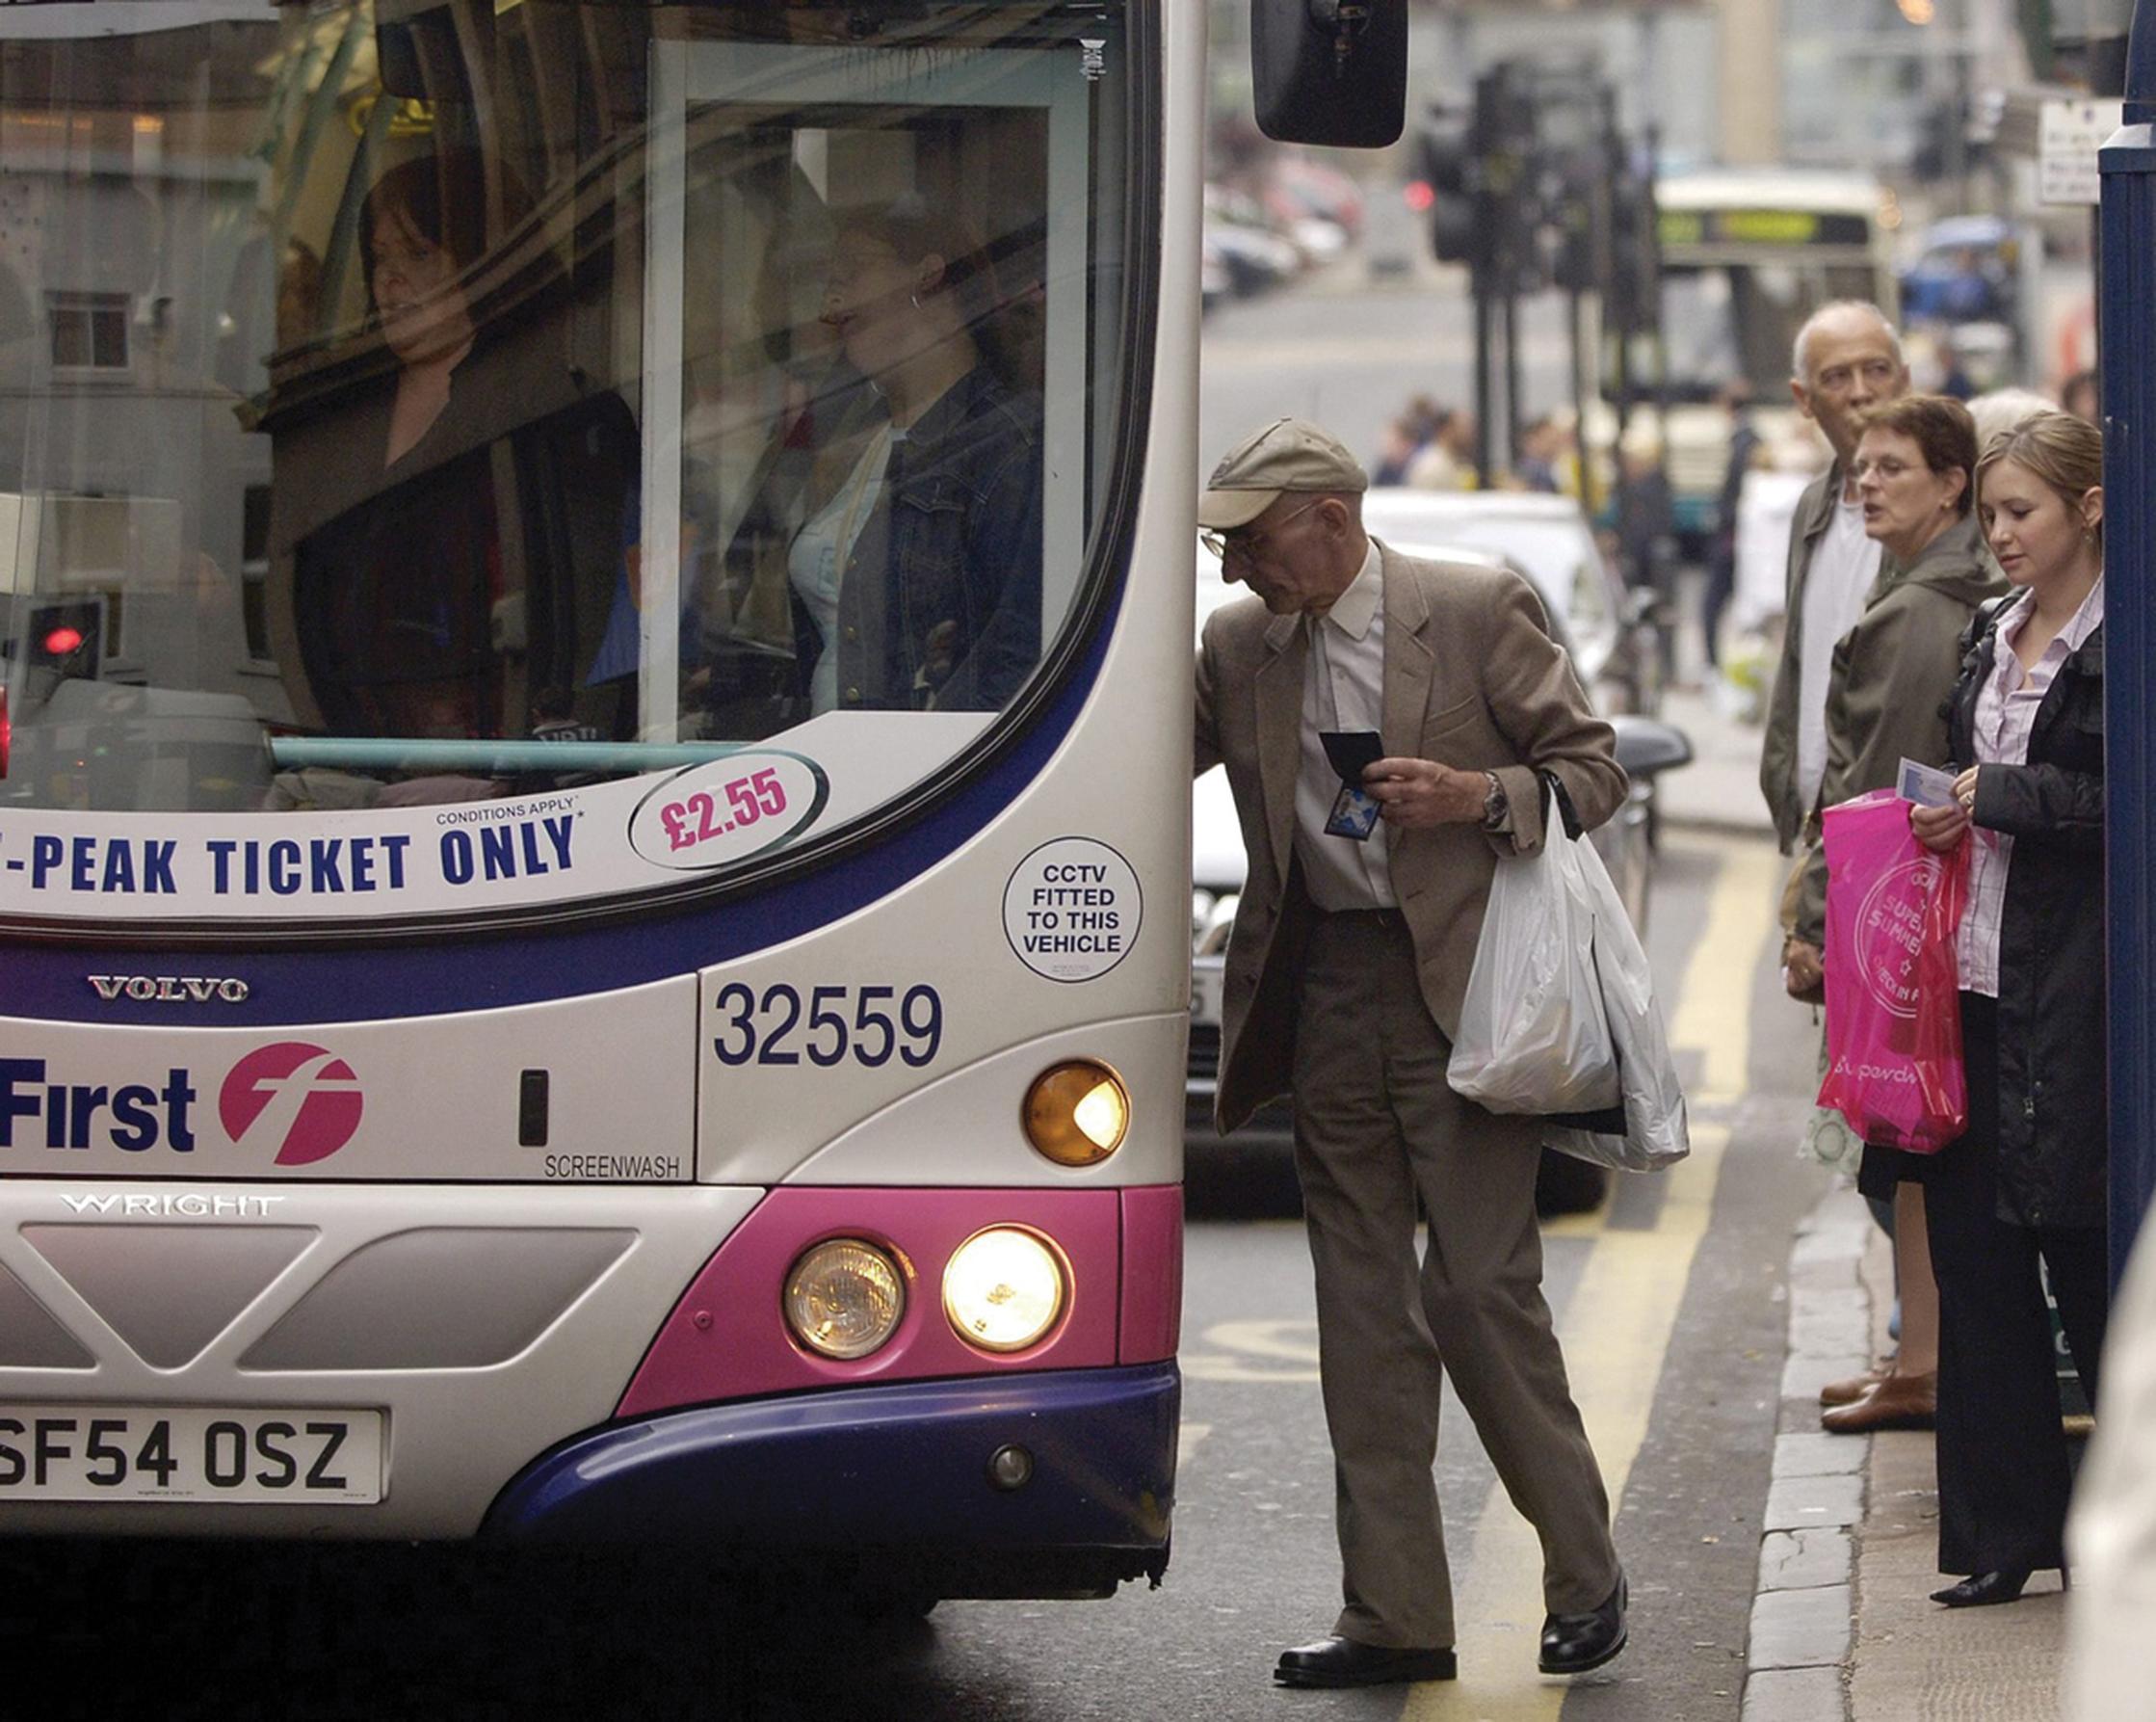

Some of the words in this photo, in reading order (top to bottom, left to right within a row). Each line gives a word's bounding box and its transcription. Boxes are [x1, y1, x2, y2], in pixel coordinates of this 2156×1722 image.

[436, 805, 525, 825] CONDITIONS
[661, 767, 787, 852] £2.55
[0, 832, 178, 894] -PEAK
[206, 835, 410, 895] TICKET
[1043, 864, 1107, 883] CCTV
[1033, 887, 1115, 907] FITTED
[1027, 911, 1059, 930] TO
[1066, 911, 1119, 930] THIS
[1023, 935, 1121, 953] VEHICLE
[89, 975, 250, 1002] VOLVO
[714, 982, 943, 1068] 32559
[0, 1058, 197, 1152] First
[544, 1154, 680, 1178] SCREENWASH
[59, 1194, 286, 1217] WRIGHT
[0, 1418, 178, 1487] SF54
[204, 1420, 348, 1490] OSZ
